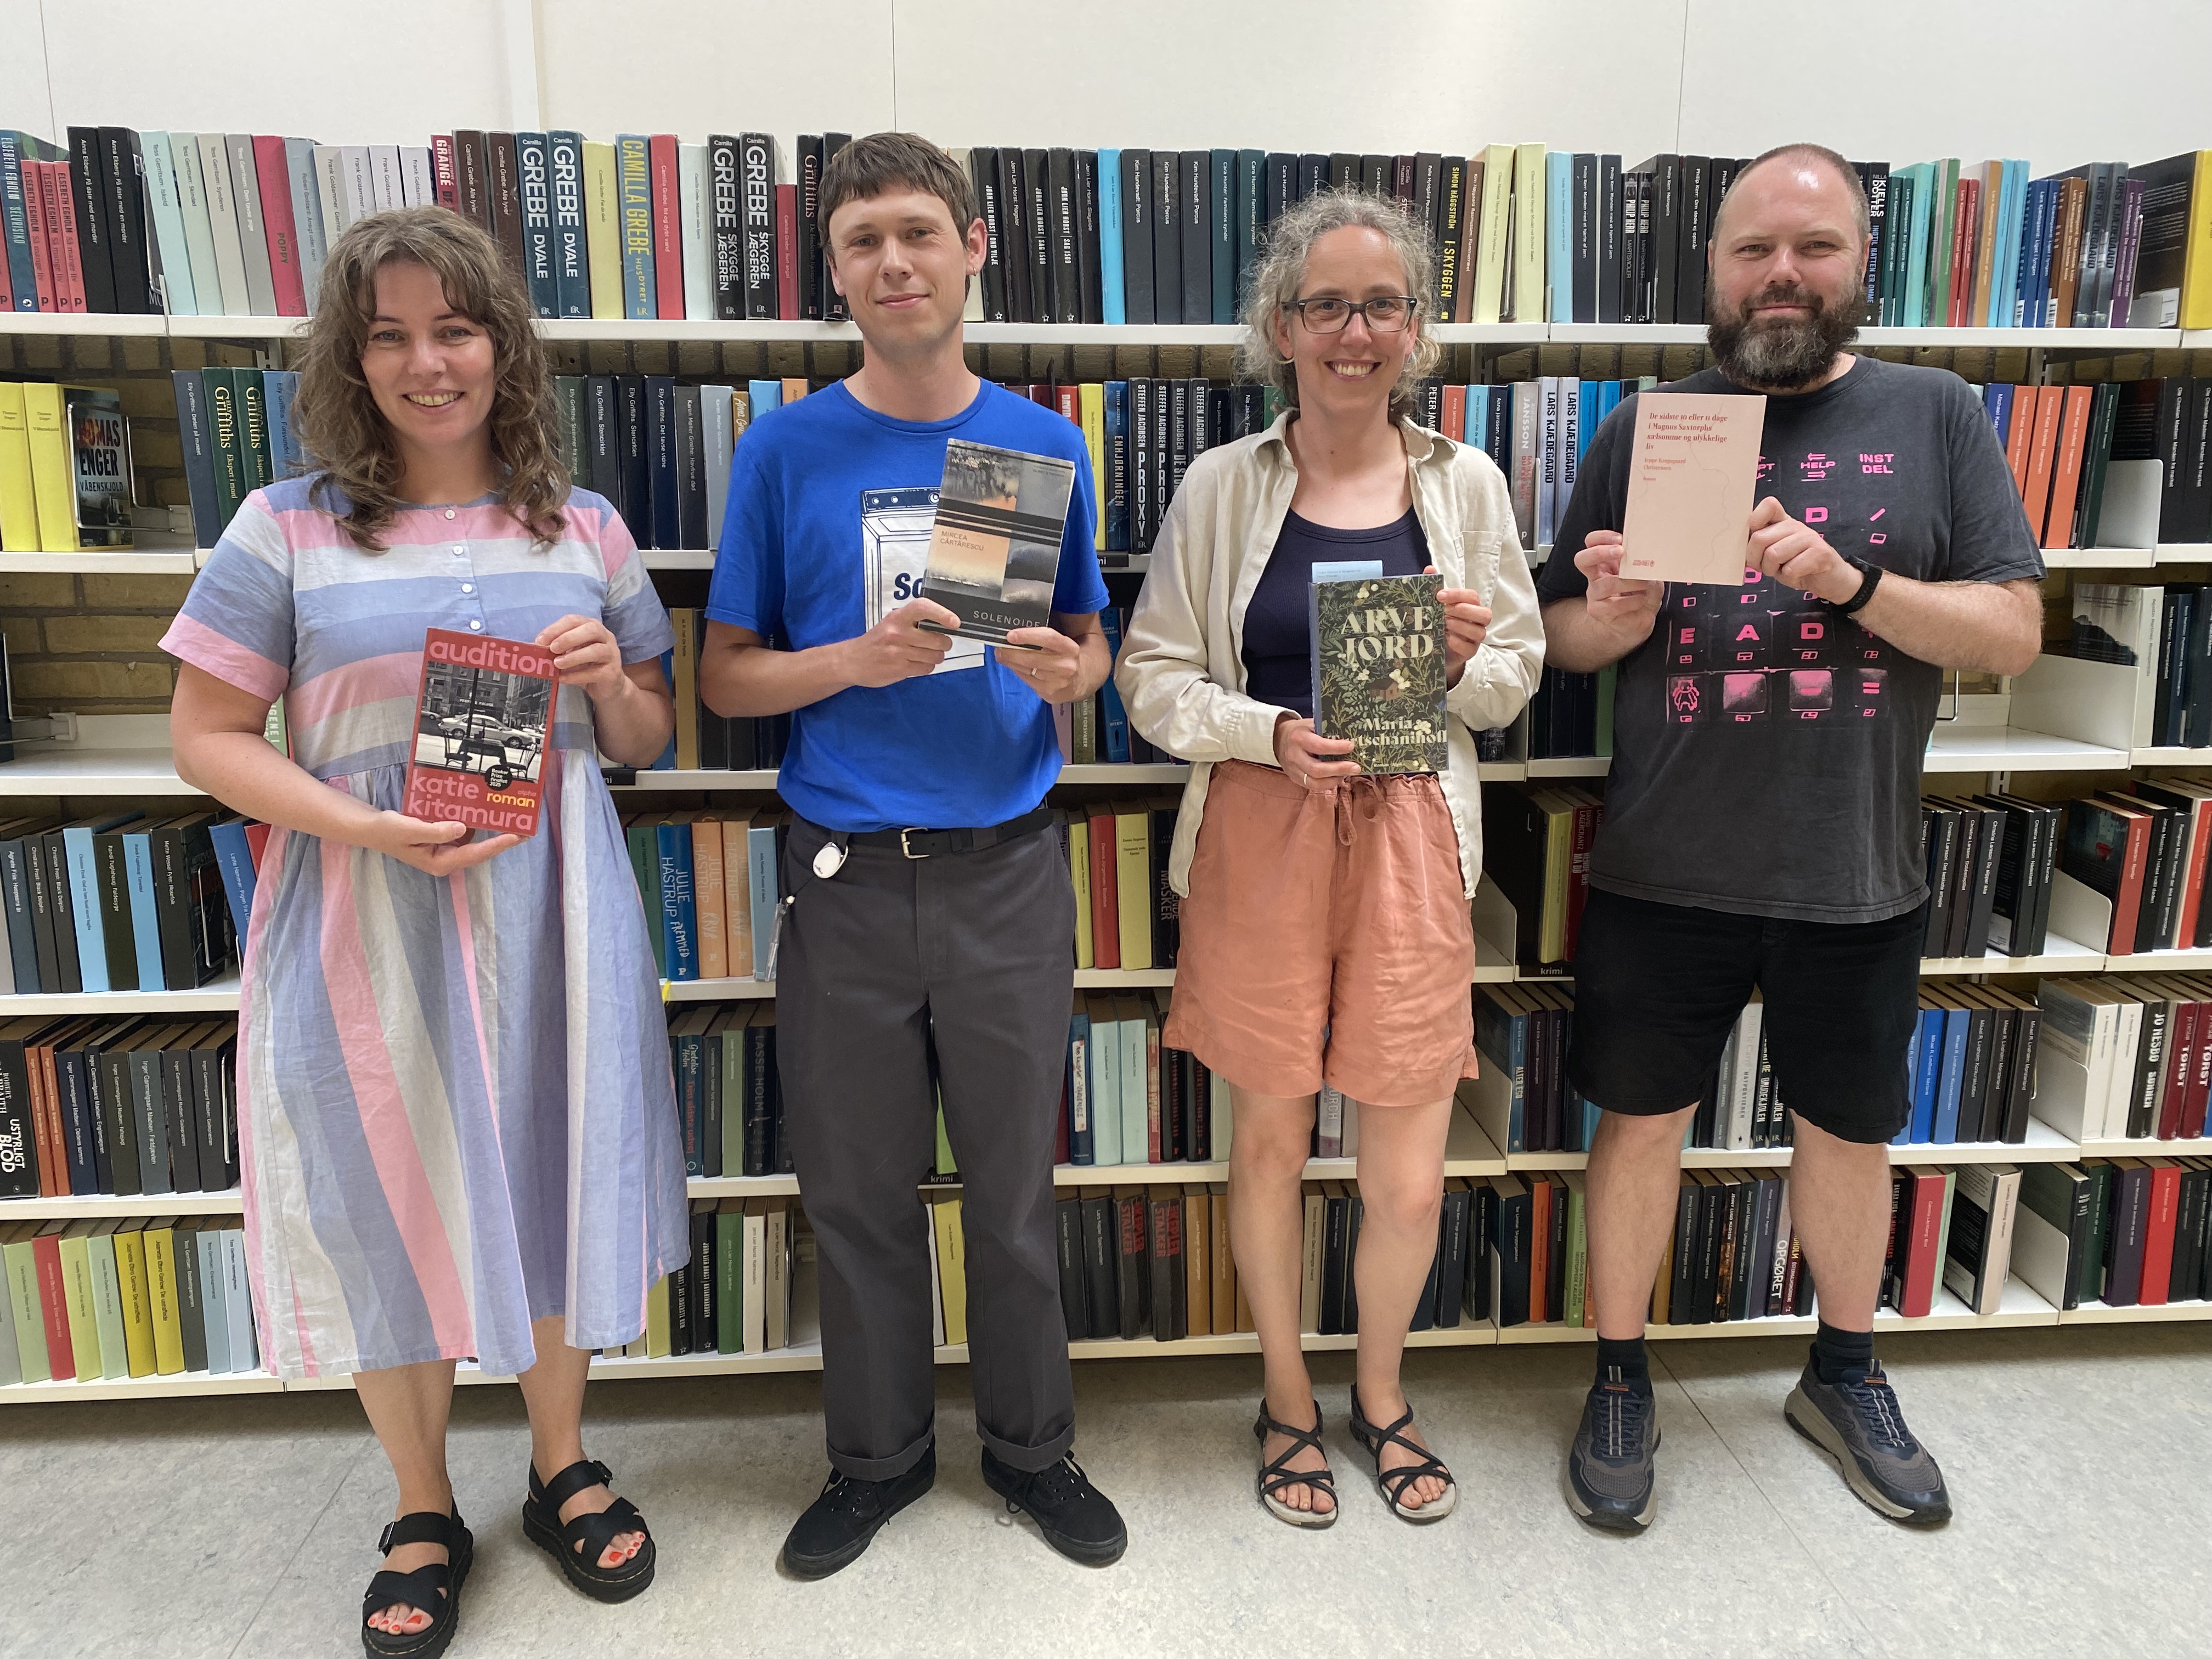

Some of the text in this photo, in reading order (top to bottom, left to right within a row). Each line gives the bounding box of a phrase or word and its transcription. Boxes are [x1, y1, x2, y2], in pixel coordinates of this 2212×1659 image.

[436, 139, 454, 187] GRANGÉ
[1451, 167, 1459, 188] SIMON
[1, 138, 25, 244] ELSEBETH EGHOLM SELVRISIKO
[58, 173, 74, 233] ELSEBETH EGHOLM
[523, 146, 549, 228] GREBE
[1870, 180, 1879, 217] DOTTER
[1877, 180, 1887, 217] KJELLS
[89, 214, 95, 222] en
[554, 145, 579, 278] GREBE DVALE
[622, 139, 650, 303] CAMILLA GREBE HUSDYRET
[714, 148, 737, 228] GREBE
[727, 233, 738, 281] SKYGGE
[746, 146, 770, 280] GREBE SKYGGE
[988, 215, 996, 233] HORST
[1448, 190, 1458, 229] HÄGGSTRÖM
[1625, 199, 1636, 234] PHILIP KERR
[277, 233, 288, 263] POPPY
[533, 234, 548, 279] DVALE
[717, 233, 729, 291] JÆGEREN
[748, 232, 760, 290] JÆGEREN
[990, 250, 998, 265] VILJE
[1867, 225, 1880, 303] INDTIL NATTEN ER OMME
[1441, 248, 1455, 297] SKYGGEN
[1137, 385, 1146, 415] STEFFEN
[1158, 386, 1166, 416] STEFFEN
[1428, 386, 1437, 409] PETER
[246, 387, 264, 449] Griffiths
[1521, 397, 1530, 449] JANSSON
[1652, 423, 1677, 431] Magnus
[1679, 424, 1712, 432] Saxtorphs
[1712, 414, 1728, 423] dage
[215, 386, 234, 448] Griffiths
[230, 483, 238, 499] mord
[1545, 392, 1556, 483] LARS KJÆDEGAARD
[1565, 392, 1577, 483] LARS KJÆDEGAARD
[1693, 434, 1727, 443] ulykkelige
[78, 449, 119, 476] ENGER
[1114, 435, 1124, 507] ENHJØRNINGEN
[1801, 461, 1836, 469] HELP
[1859, 453, 1894, 463] INST
[1862, 464, 1893, 474] DEL
[79, 479, 124, 492] VÅBENSKJOLD
[1137, 451, 1146, 537] PROXY
[1805, 507, 1829, 522] D
[941, 531, 967, 540] MIRCEA
[973, 611, 1041, 627] SOLENOIDE
[1341, 606, 1433, 635] ARVE
[1680, 623, 1824, 644] E A D
[429, 641, 555, 676] audition
[1345, 634, 1434, 664] JORD
[1365, 716, 1412, 731] Maria
[411, 771, 479, 799] katie
[487, 793, 535, 808] roman
[408, 793, 533, 831] kitamura
[1577, 811, 1585, 850] LAGERCRANTZ
[675, 870, 690, 904] JULIE
[1161, 870, 1172, 921] MASKER
[661, 857, 690, 957] HASTRUP FREMMED
[1541, 967, 1563, 975] krimi
[2154, 1014, 2165, 1026] JO
[755, 1036, 765, 1111] LASSE HOLM
[2177, 1045, 2190, 1087] TØRST
[2199, 1043, 2212, 1086] TØRST
[0, 1135, 15, 1173] BLOD
[10, 1119, 25, 1169] USTYRLIGT
[1121, 1205, 1132, 1255] STALKER
[1770, 1239, 1788, 1299] OPGØRET
